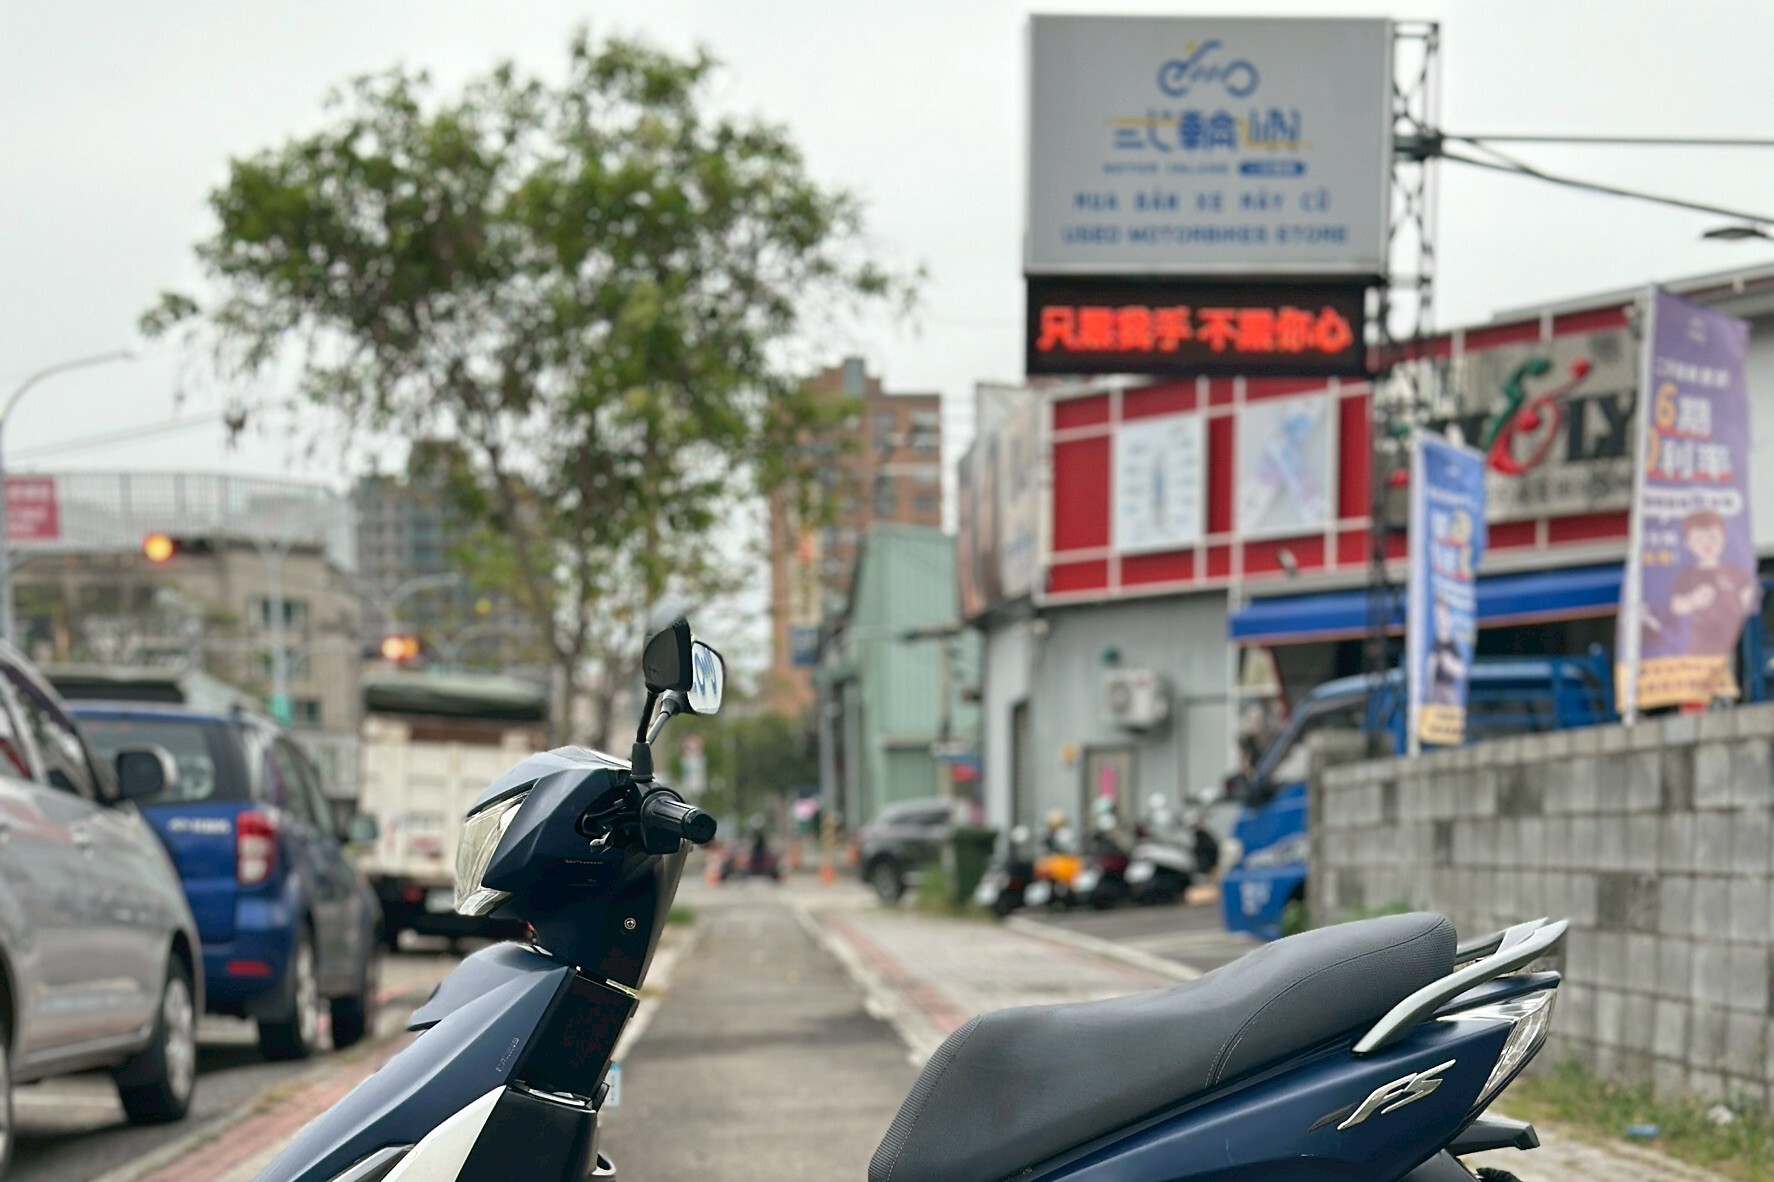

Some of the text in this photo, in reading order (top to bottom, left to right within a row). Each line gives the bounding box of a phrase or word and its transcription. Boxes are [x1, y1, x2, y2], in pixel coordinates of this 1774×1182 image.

[1062, 225, 1349, 244] USED MOTORBIKES STORE
